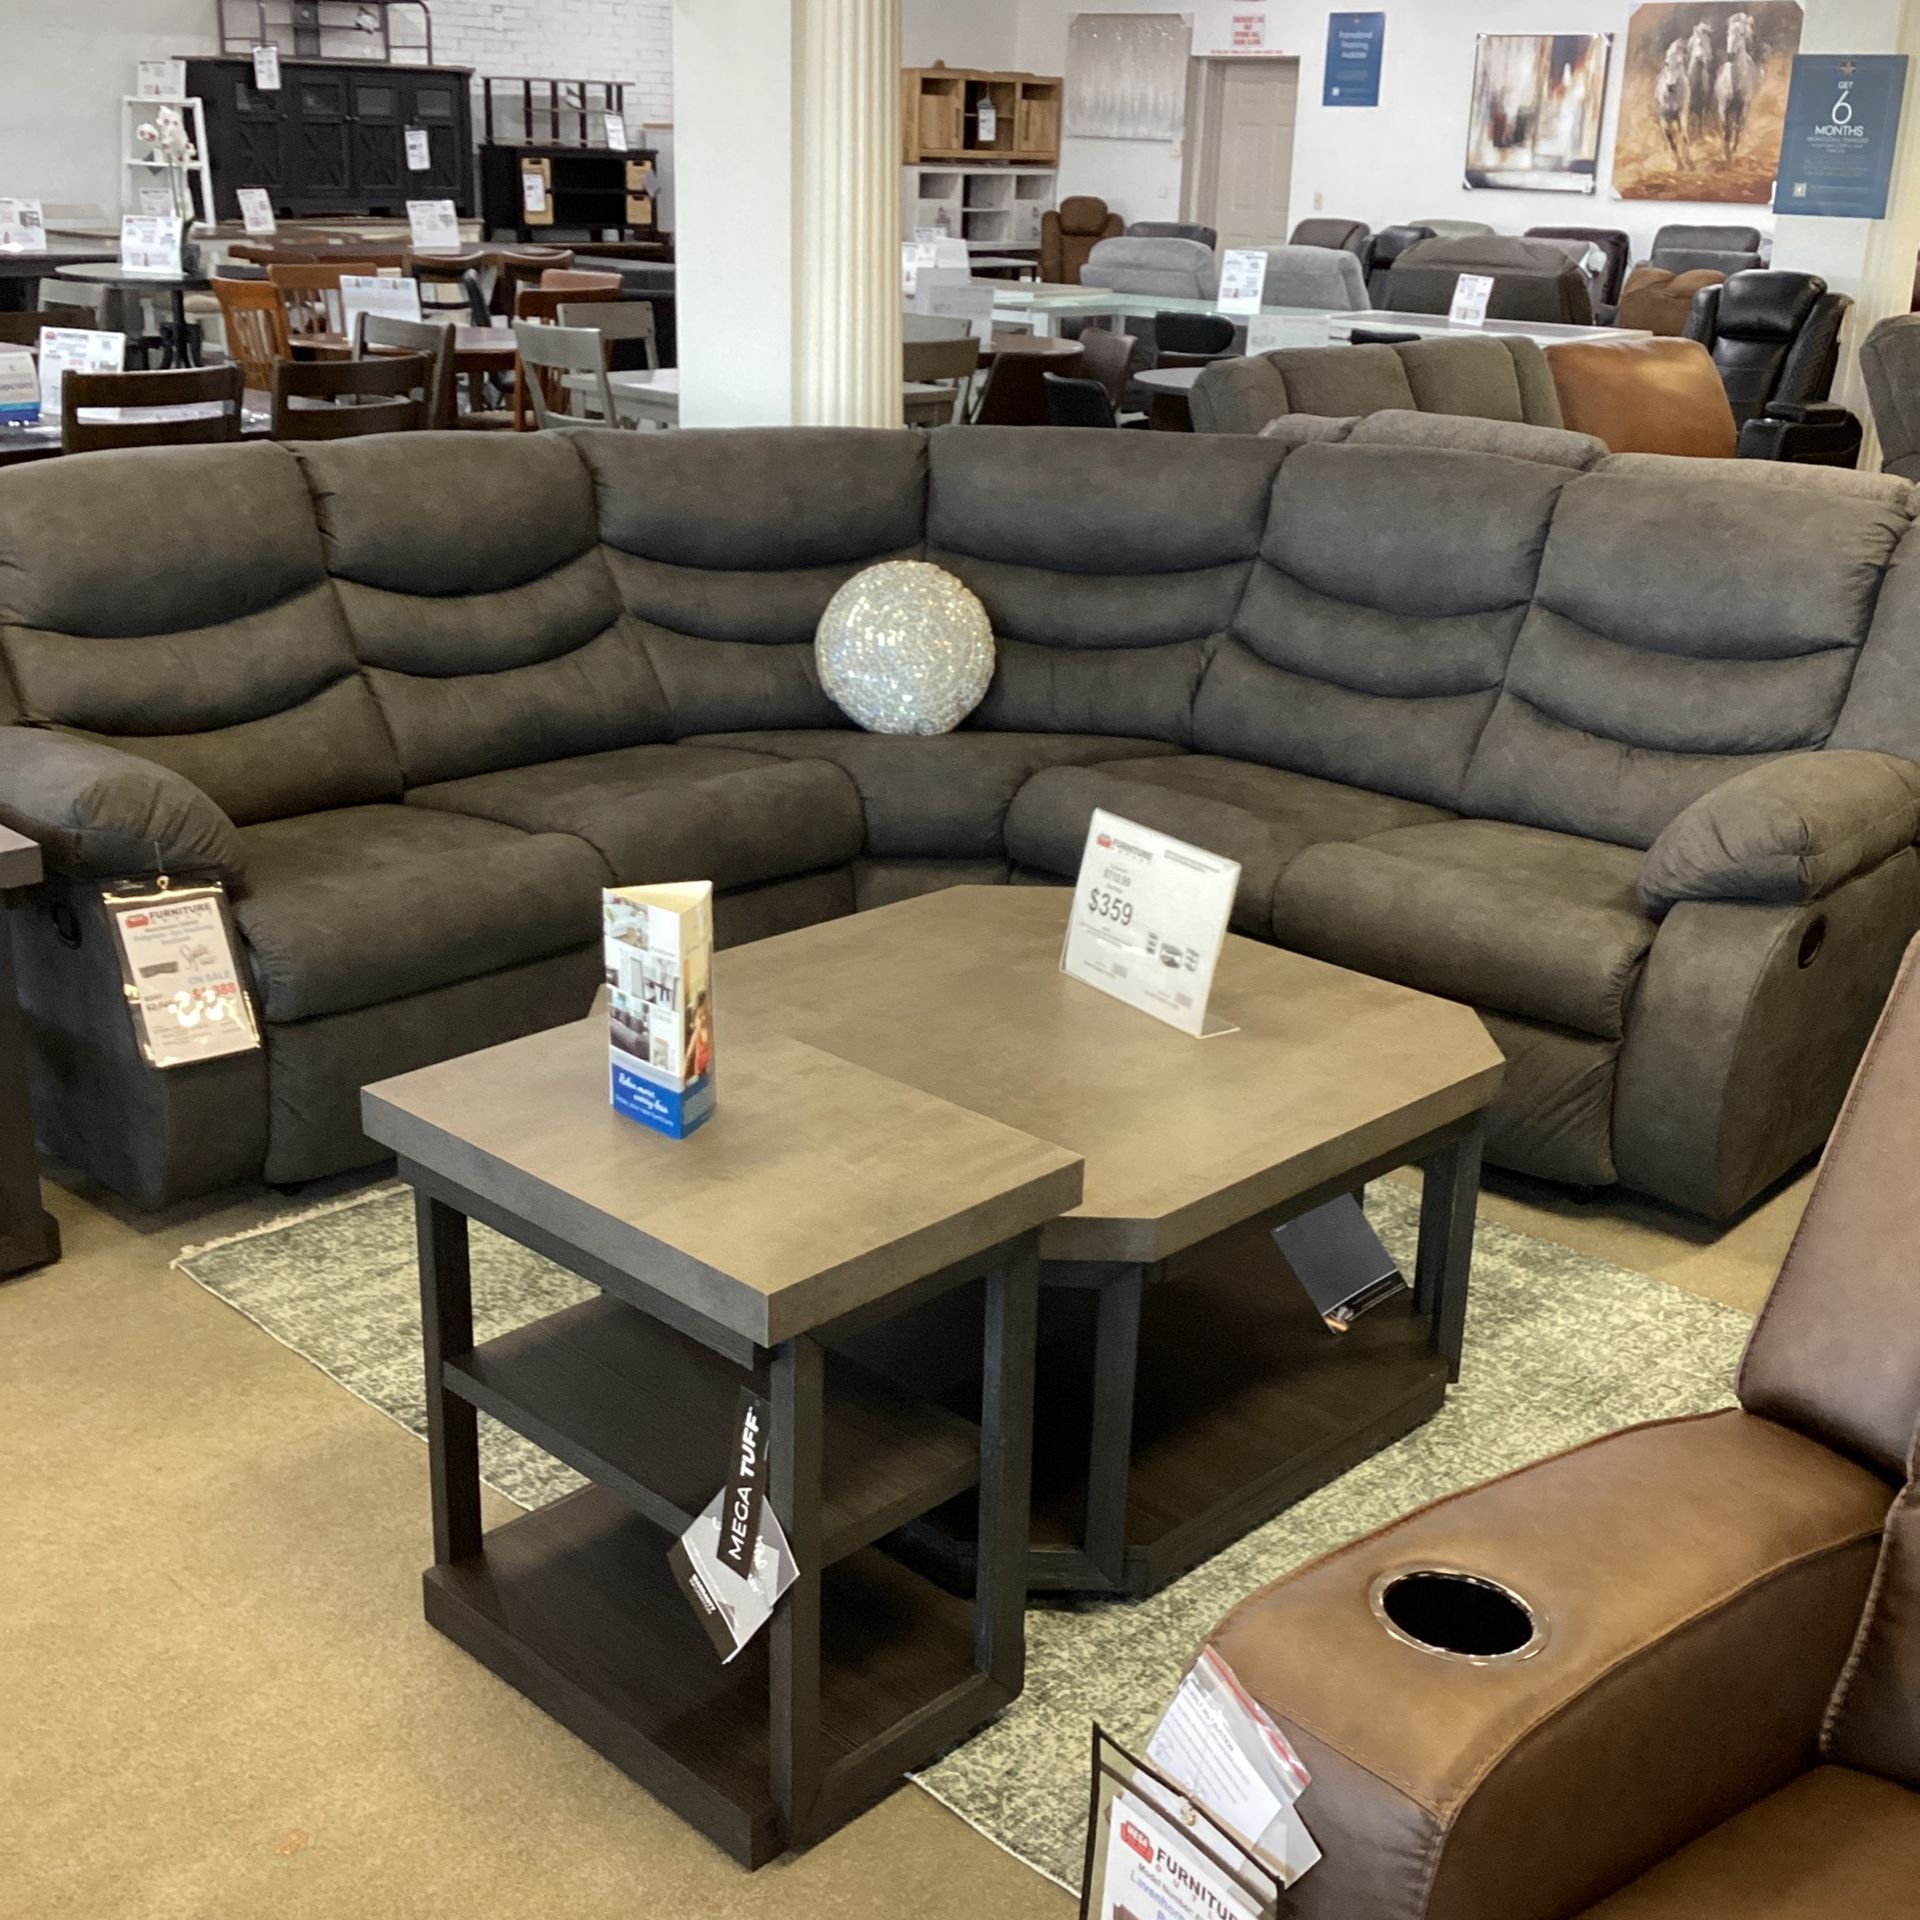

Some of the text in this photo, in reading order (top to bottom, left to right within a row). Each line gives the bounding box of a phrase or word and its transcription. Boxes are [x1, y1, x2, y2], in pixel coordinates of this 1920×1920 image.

[1838, 81, 1853, 89] GET
[1832, 90, 1853, 125] 6
[1815, 125, 1864, 136] MONTHS
[149, 902, 211, 920] FURNITURE
[1088, 887, 1133, 926] $359
[727, 1409, 760, 1561] MEGA TUFF
